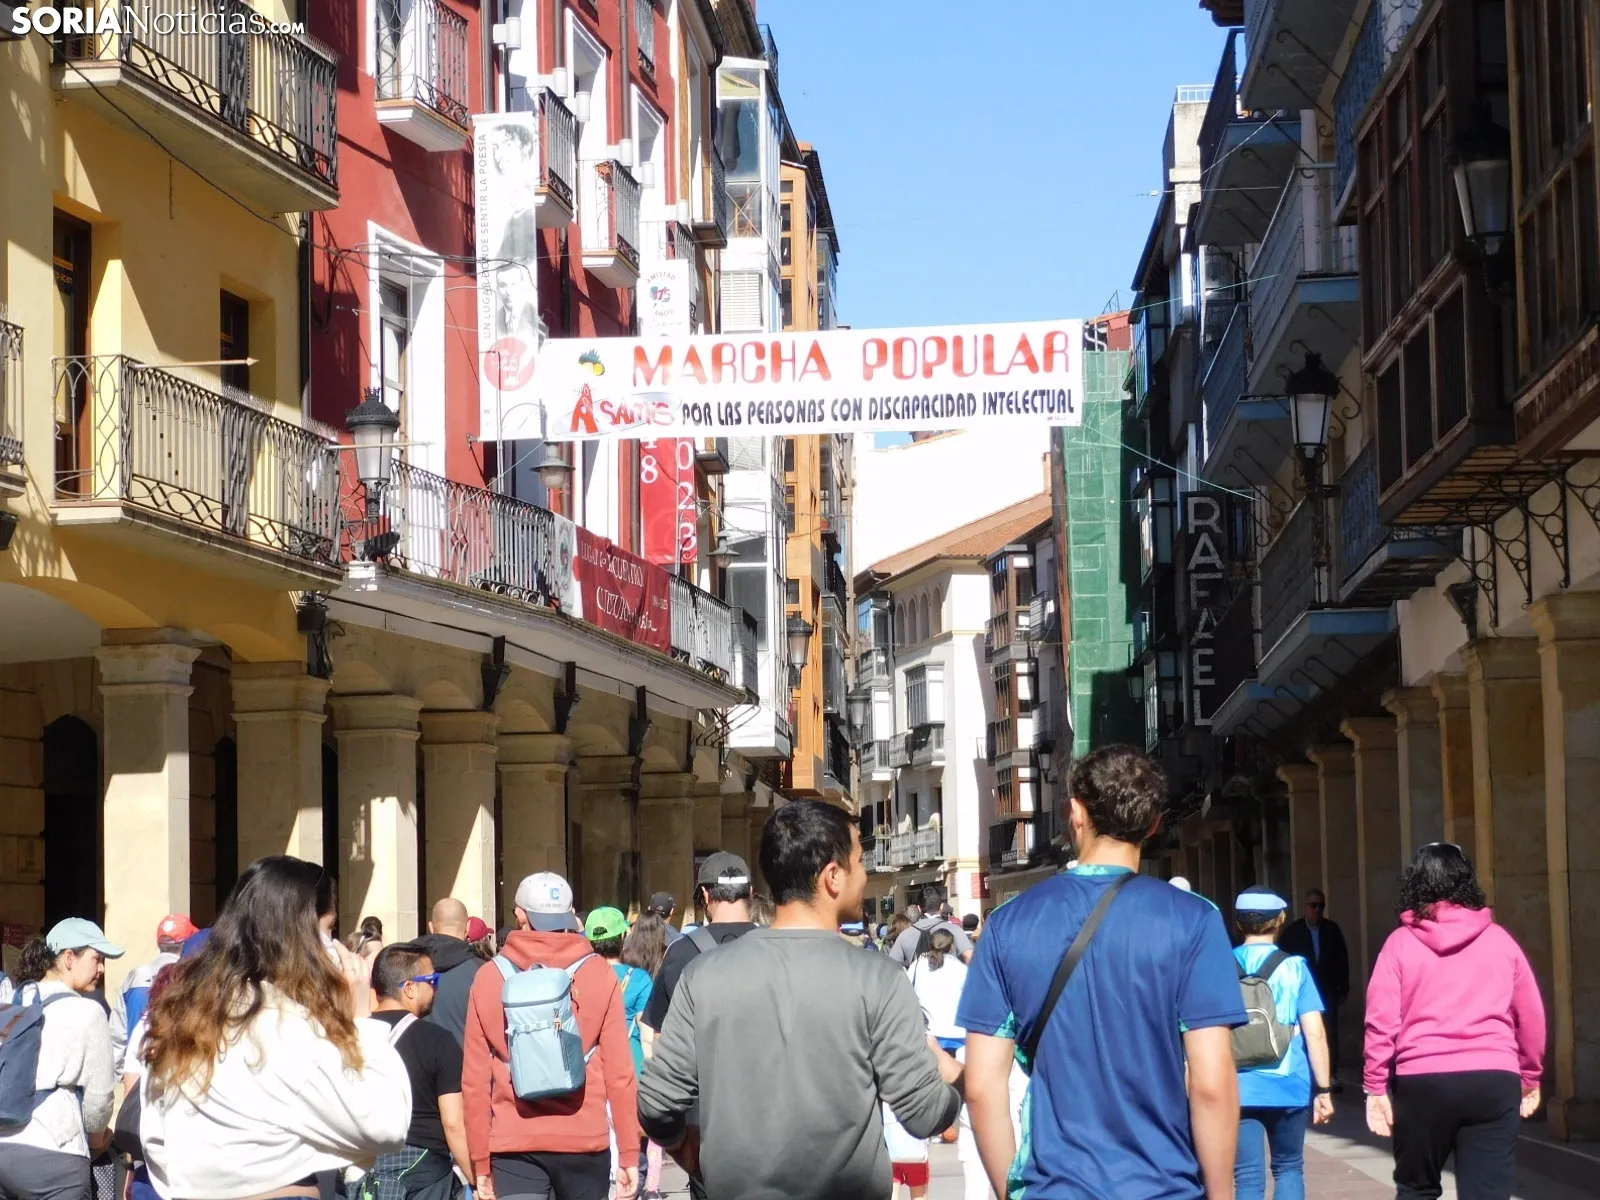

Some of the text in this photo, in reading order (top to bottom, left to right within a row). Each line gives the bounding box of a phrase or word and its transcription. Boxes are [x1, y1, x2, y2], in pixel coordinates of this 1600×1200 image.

[479, 178, 488, 193] LA
[480, 195, 489, 235] SENTIR
[482, 281, 492, 319] LUGAR
[483, 322, 492, 340] UN
[633, 329, 1069, 387] MARCHA POPULAR
[682, 388, 1075, 426] POR LAS PERSONAS CON DISCAPACIDAD INTELECTUAL
[1187, 496, 1225, 727] RAFAEL
